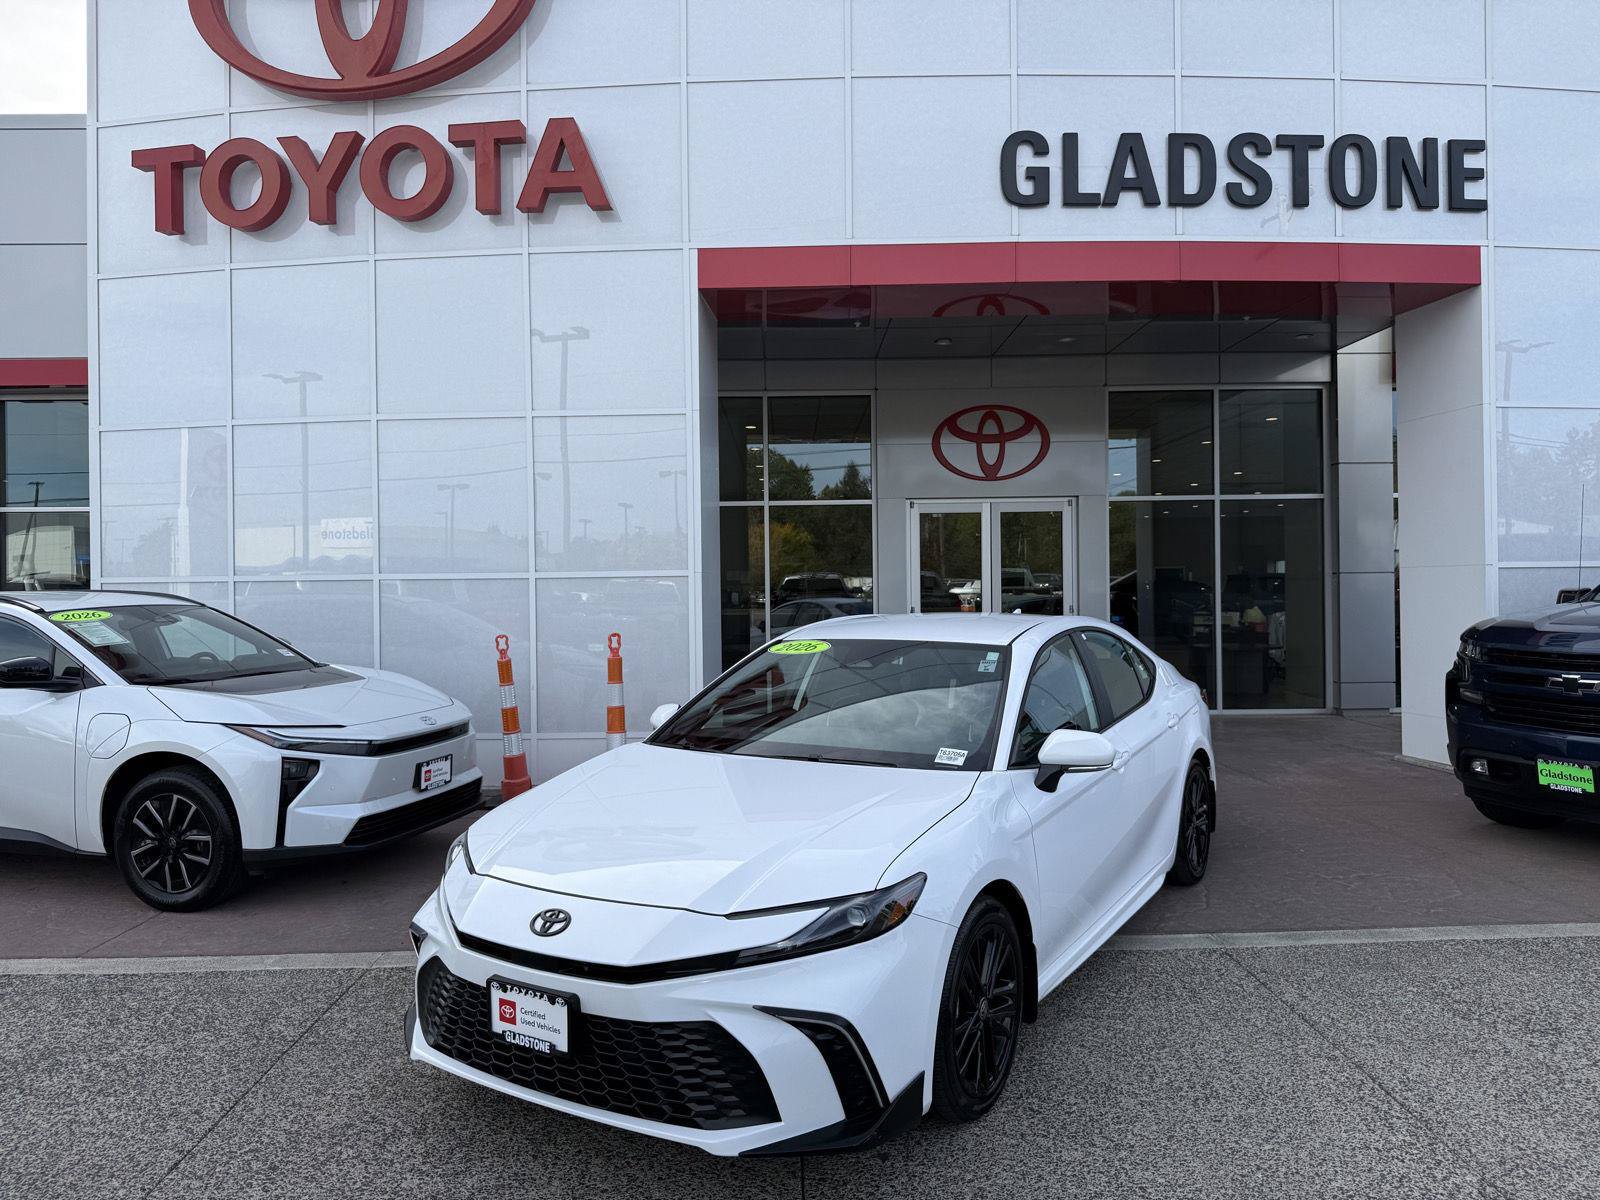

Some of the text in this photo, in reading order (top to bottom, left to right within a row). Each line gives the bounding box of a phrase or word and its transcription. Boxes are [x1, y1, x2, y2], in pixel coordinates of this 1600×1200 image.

[131, 117, 613, 236] TOYOTA
[1000, 130, 1488, 212] GLADSTONE
[61, 611, 102, 620] 2026
[774, 642, 824, 652] 2026
[1540, 768, 1593, 785] Gladstone
[1550, 783, 1583, 794] GLADSTONE
[506, 984, 549, 1002] TOYOTA
[520, 1007, 546, 1020] Certified
[520, 1017, 561, 1035] Used Vehicles
[505, 1030, 551, 1053] GLADSTONE
